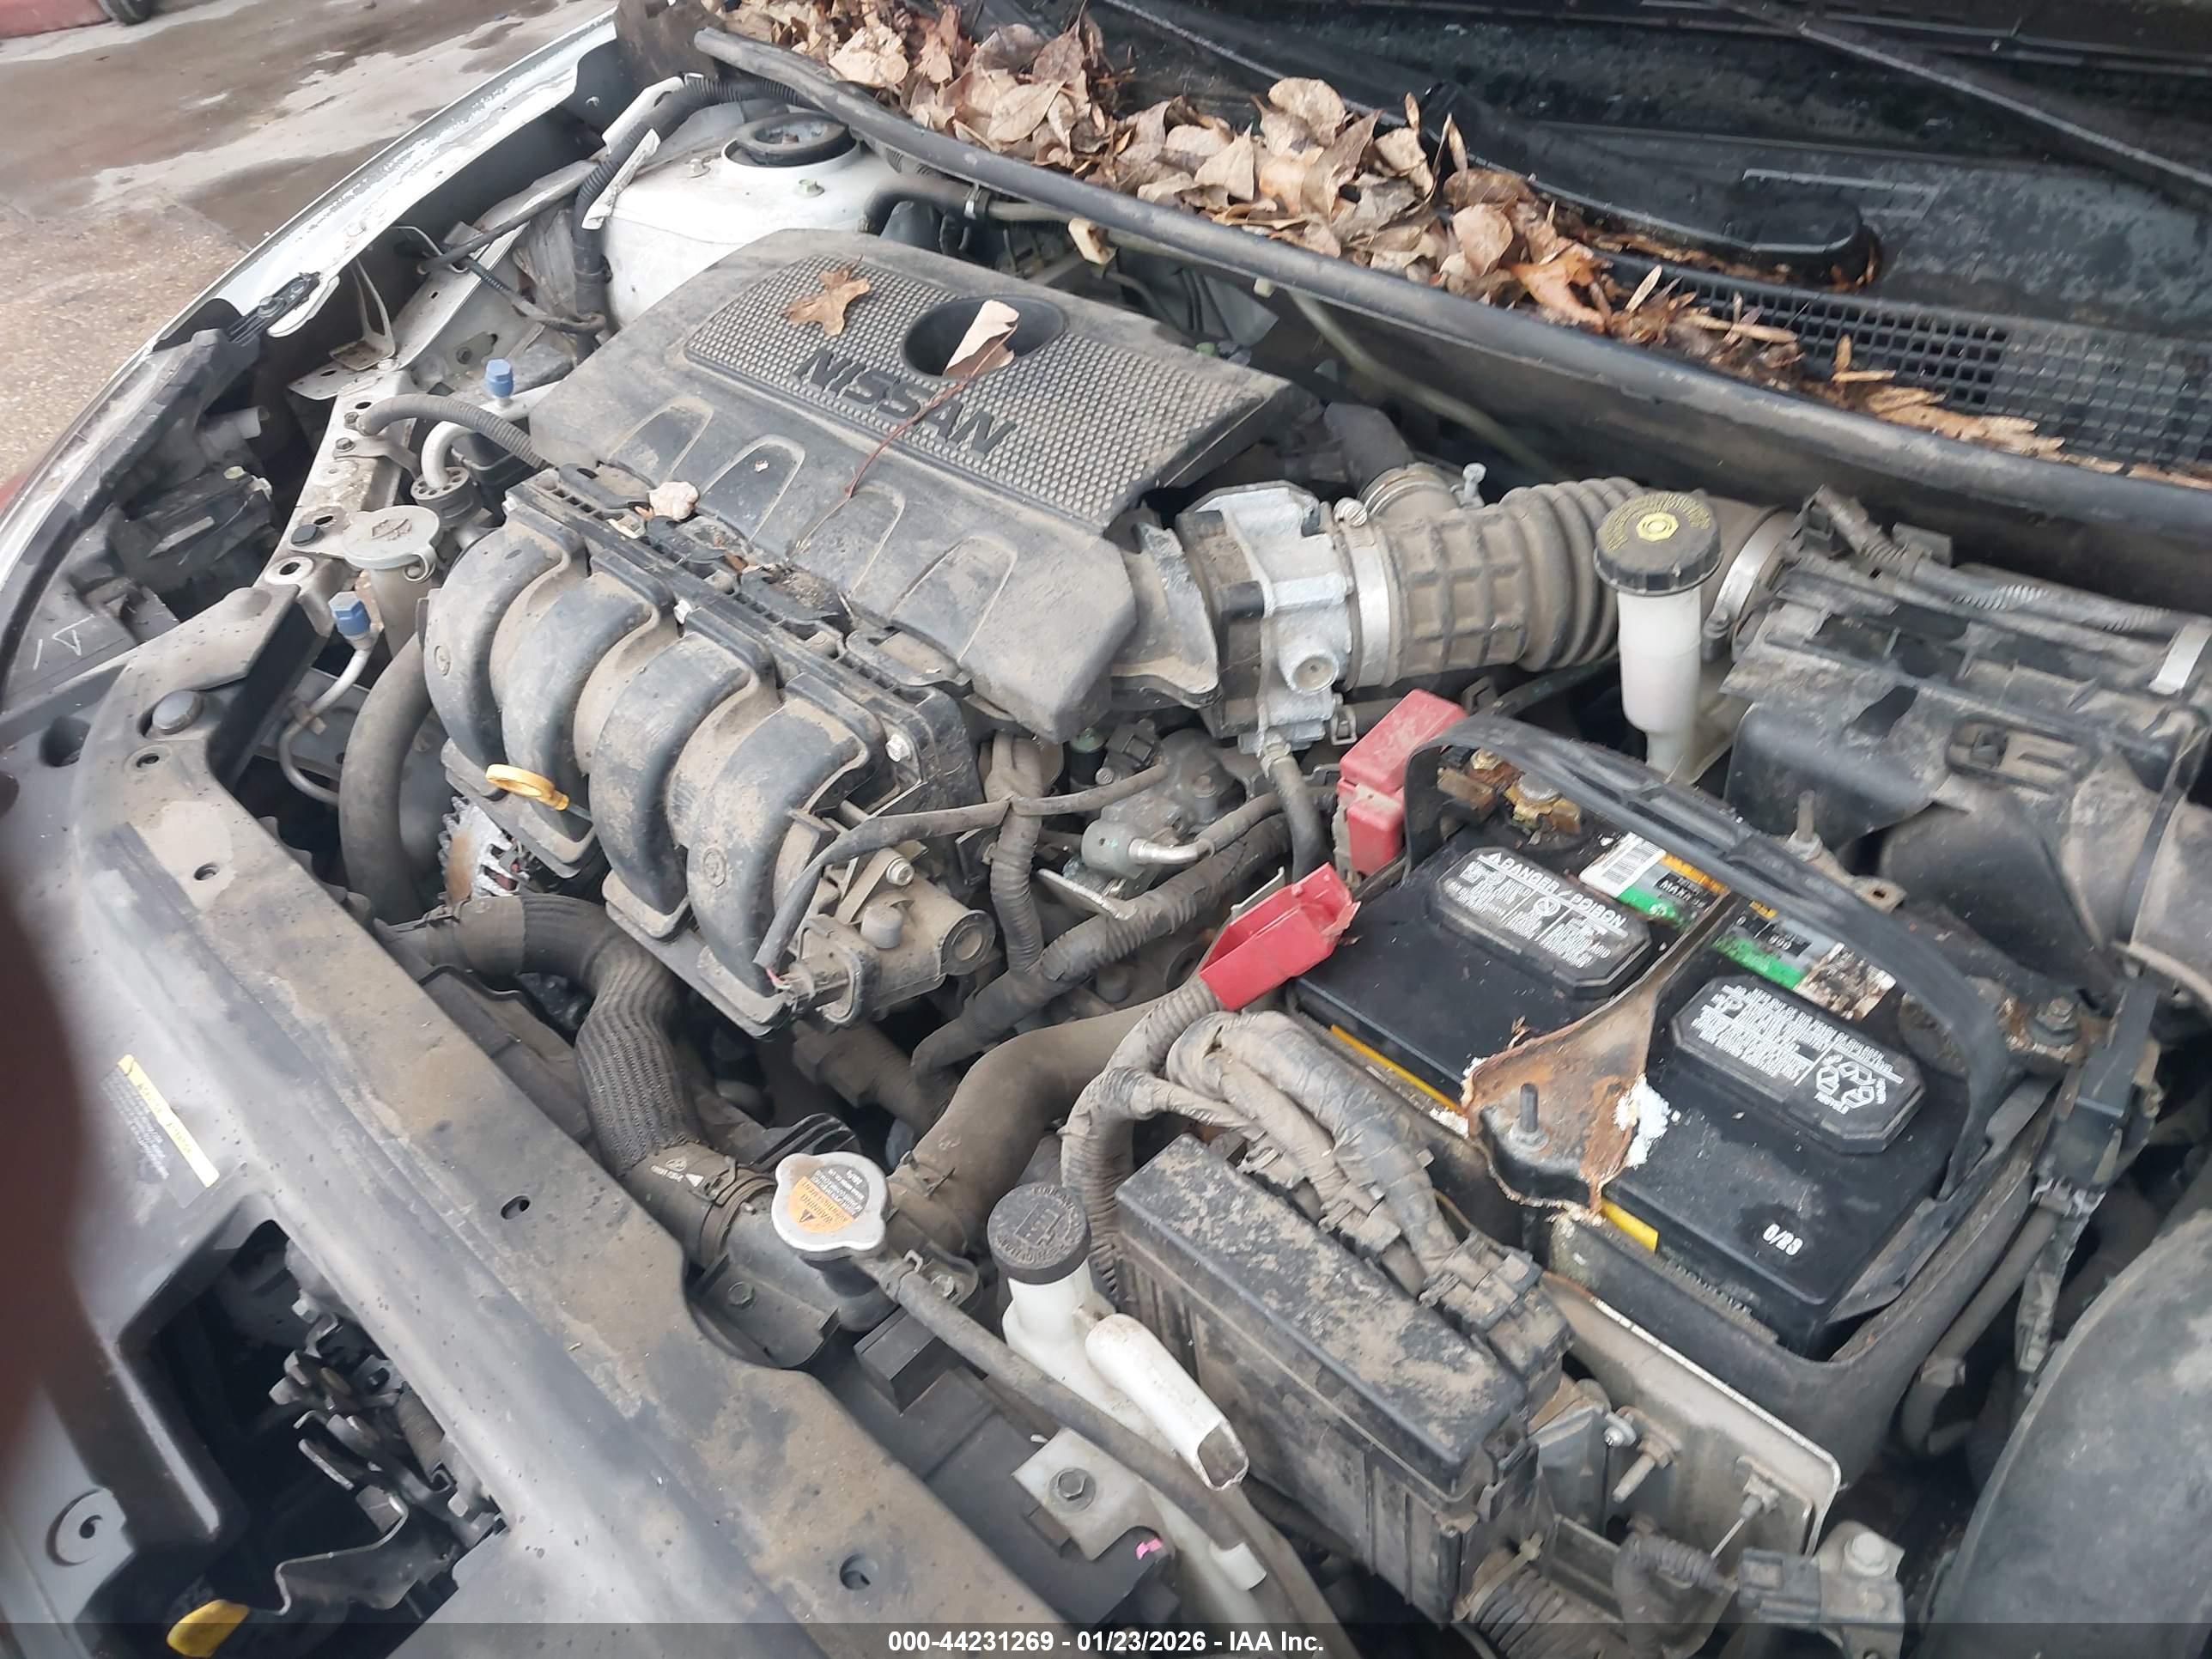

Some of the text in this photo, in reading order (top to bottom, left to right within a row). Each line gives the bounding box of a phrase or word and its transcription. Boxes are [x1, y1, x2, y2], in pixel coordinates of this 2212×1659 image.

[793, 347, 1018, 457] NISSAN
[1500, 857, 1560, 895] DANGER
[1571, 893, 1627, 929] POISON
